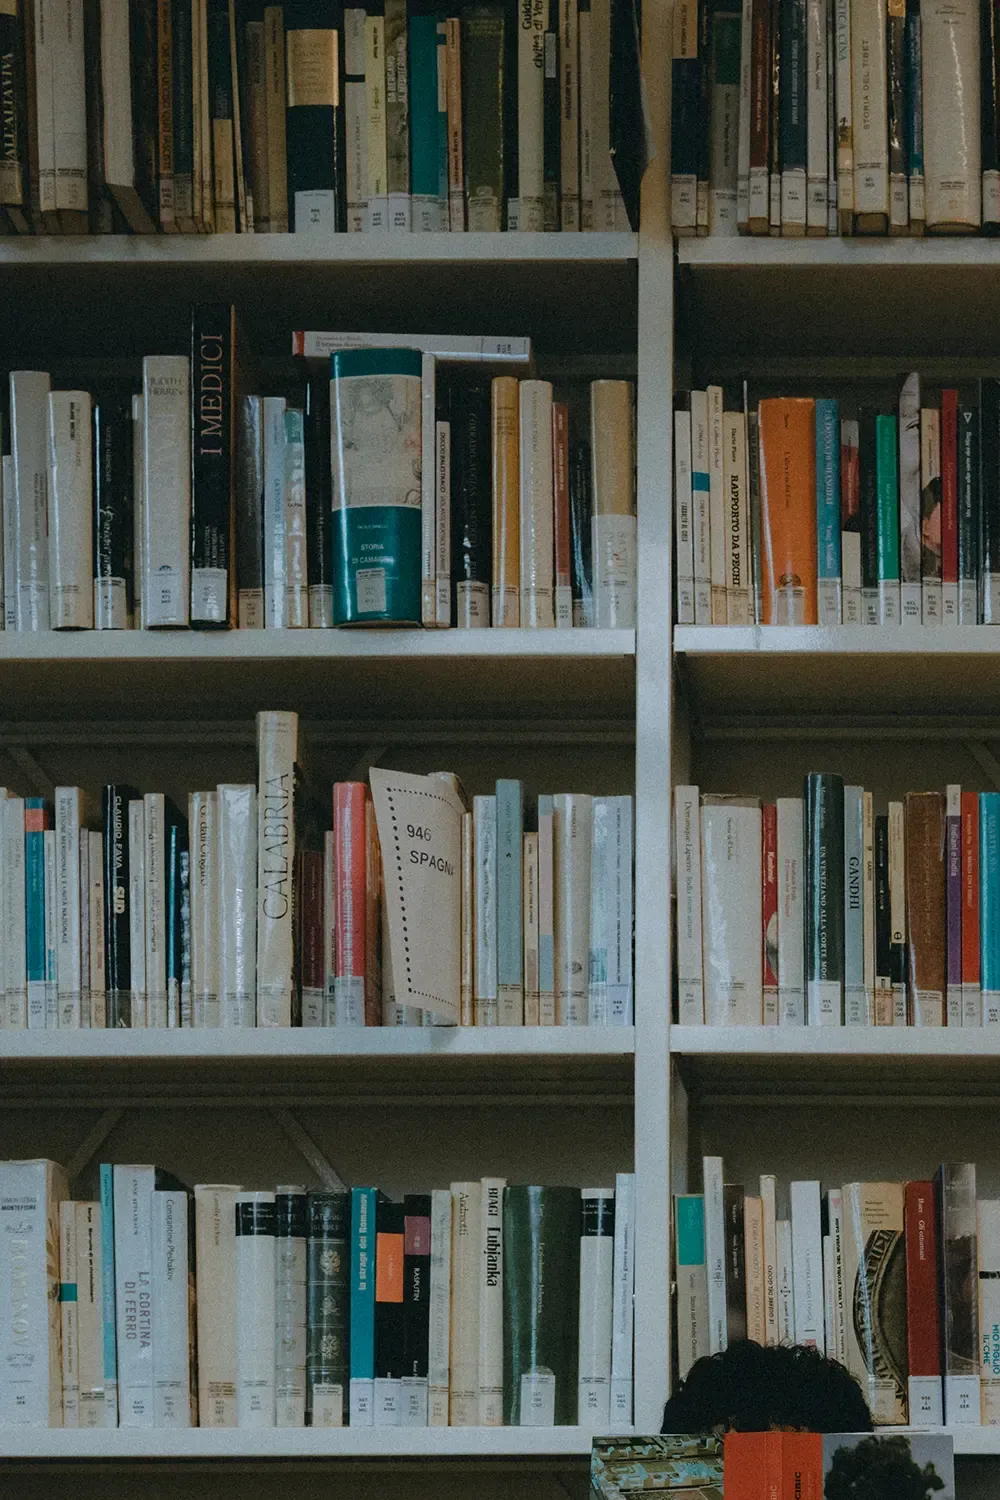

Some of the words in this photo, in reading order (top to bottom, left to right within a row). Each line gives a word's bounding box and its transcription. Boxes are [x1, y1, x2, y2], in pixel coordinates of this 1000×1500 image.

[862, 40, 870, 68] TIBET
[862, 72, 870, 92] DEL
[862, 96, 870, 131] STORIA
[200, 333, 223, 438] MEDICI
[201, 446, 223, 457] I
[730, 475, 741, 533] RAPPORTO
[360, 543, 385, 553] STORIA
[731, 534, 741, 550] DA
[731, 551, 742, 588] PECHI
[114, 796, 122, 839] CLAUDIO
[406, 824, 433, 842] 946
[683, 800, 692, 842] Dominique
[114, 843, 122, 869] FAVA
[262, 773, 289, 920] CALABRIA
[685, 842, 693, 873] Lapierre
[767, 851, 776, 885] Kashmir
[849, 856, 860, 910] GANDHI
[113, 886, 126, 914] SUD
[458, 1192, 470, 1236] Andreotti
[487, 1187, 499, 1217] BIAGI
[165, 1199, 176, 1245] Constantine
[166, 1245, 178, 1281] Pleshakov
[483, 1226, 501, 1287] Lubjanka
[124, 1281, 137, 1294] DI
[138, 1270, 150, 1286] LA
[412, 1267, 420, 1301] RASPUTIN
[124, 1299, 136, 1340] FERRO
[138, 1292, 151, 1349] CORTINA
[991, 1324, 1000, 1342] MIO
[991, 1343, 1000, 1376] FIGLIO
[794, 1471, 802, 1500] CIBIC
